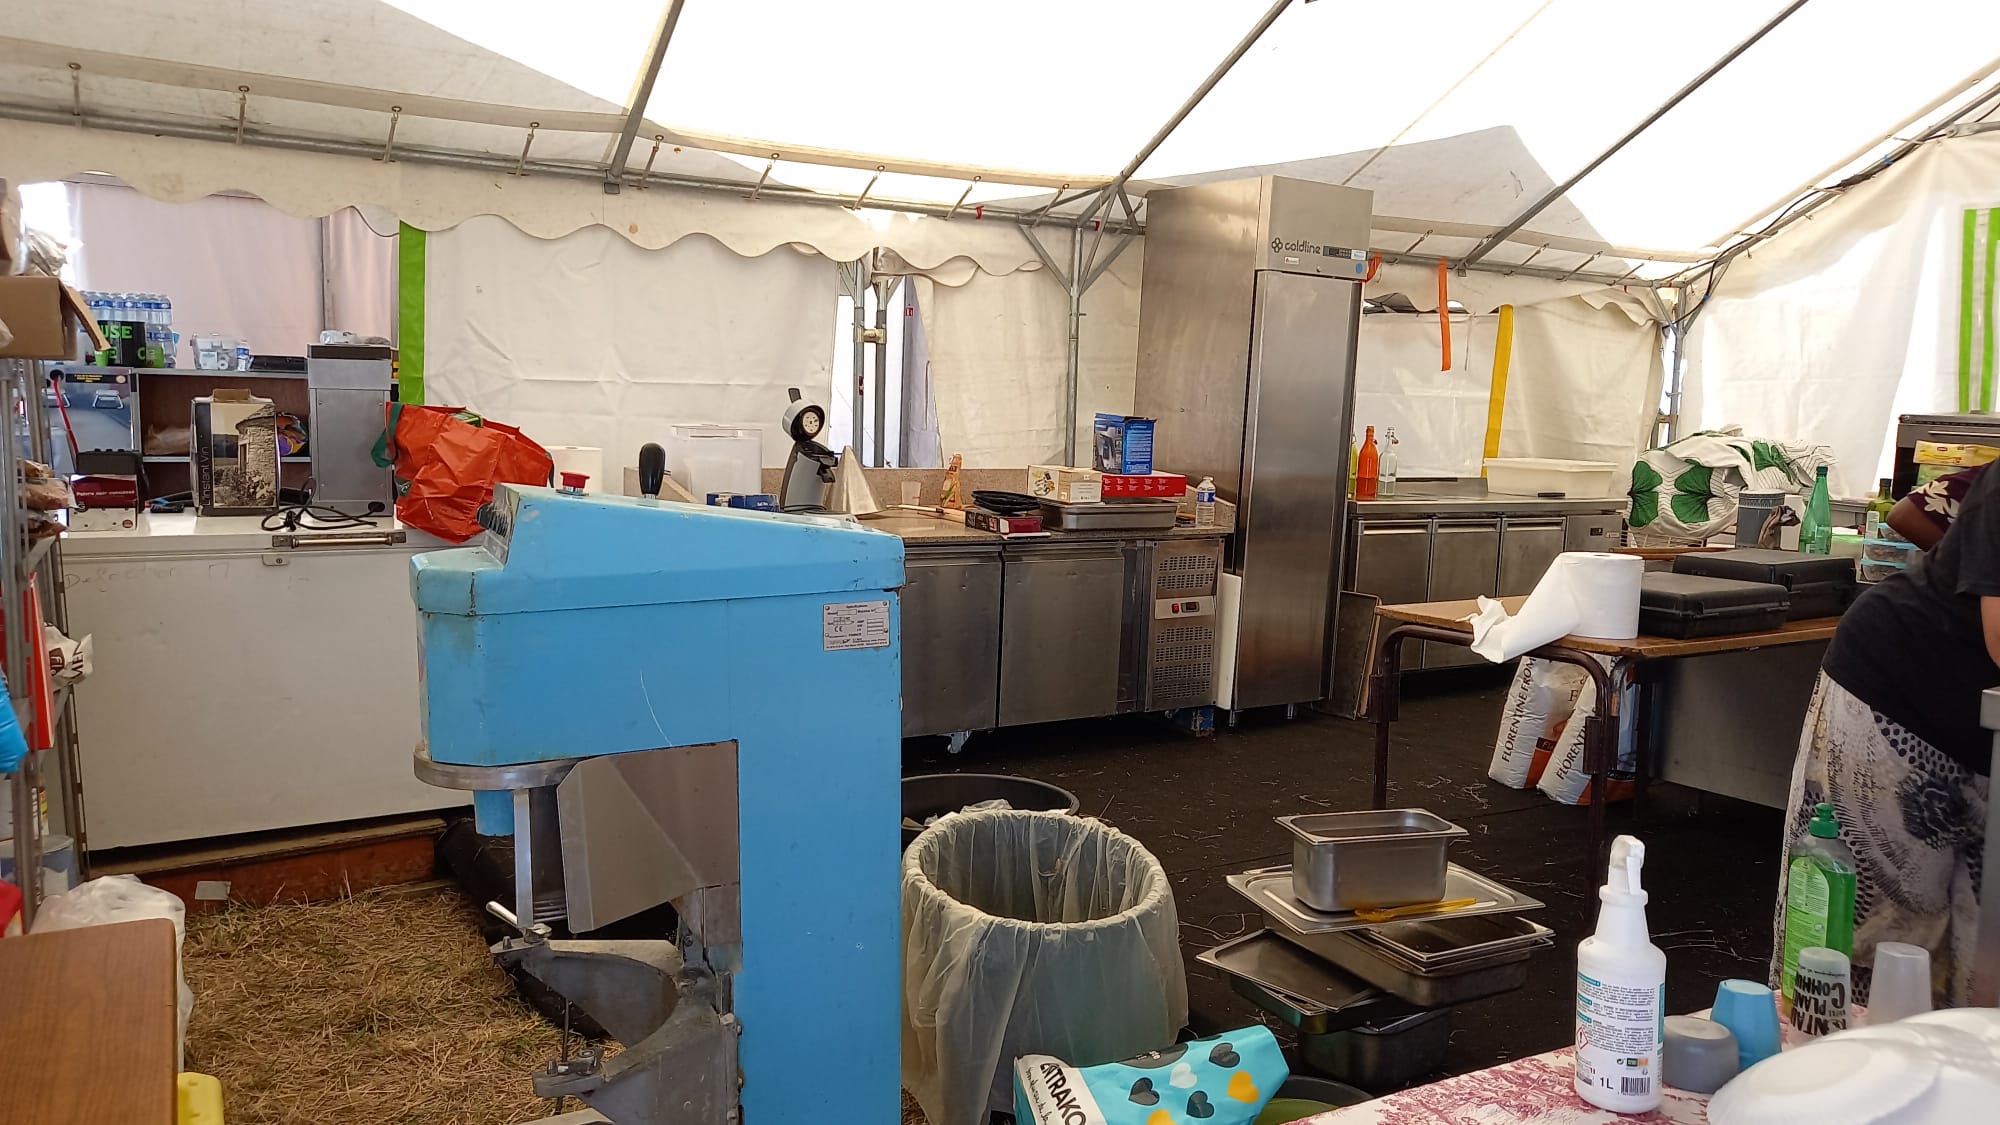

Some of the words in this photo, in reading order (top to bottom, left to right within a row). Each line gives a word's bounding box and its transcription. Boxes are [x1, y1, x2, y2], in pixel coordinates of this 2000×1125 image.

[1284, 240, 1321, 255] coldline
[1502, 692, 1528, 763] FLORENTINE
[1556, 724, 1587, 780] FLORENTI
